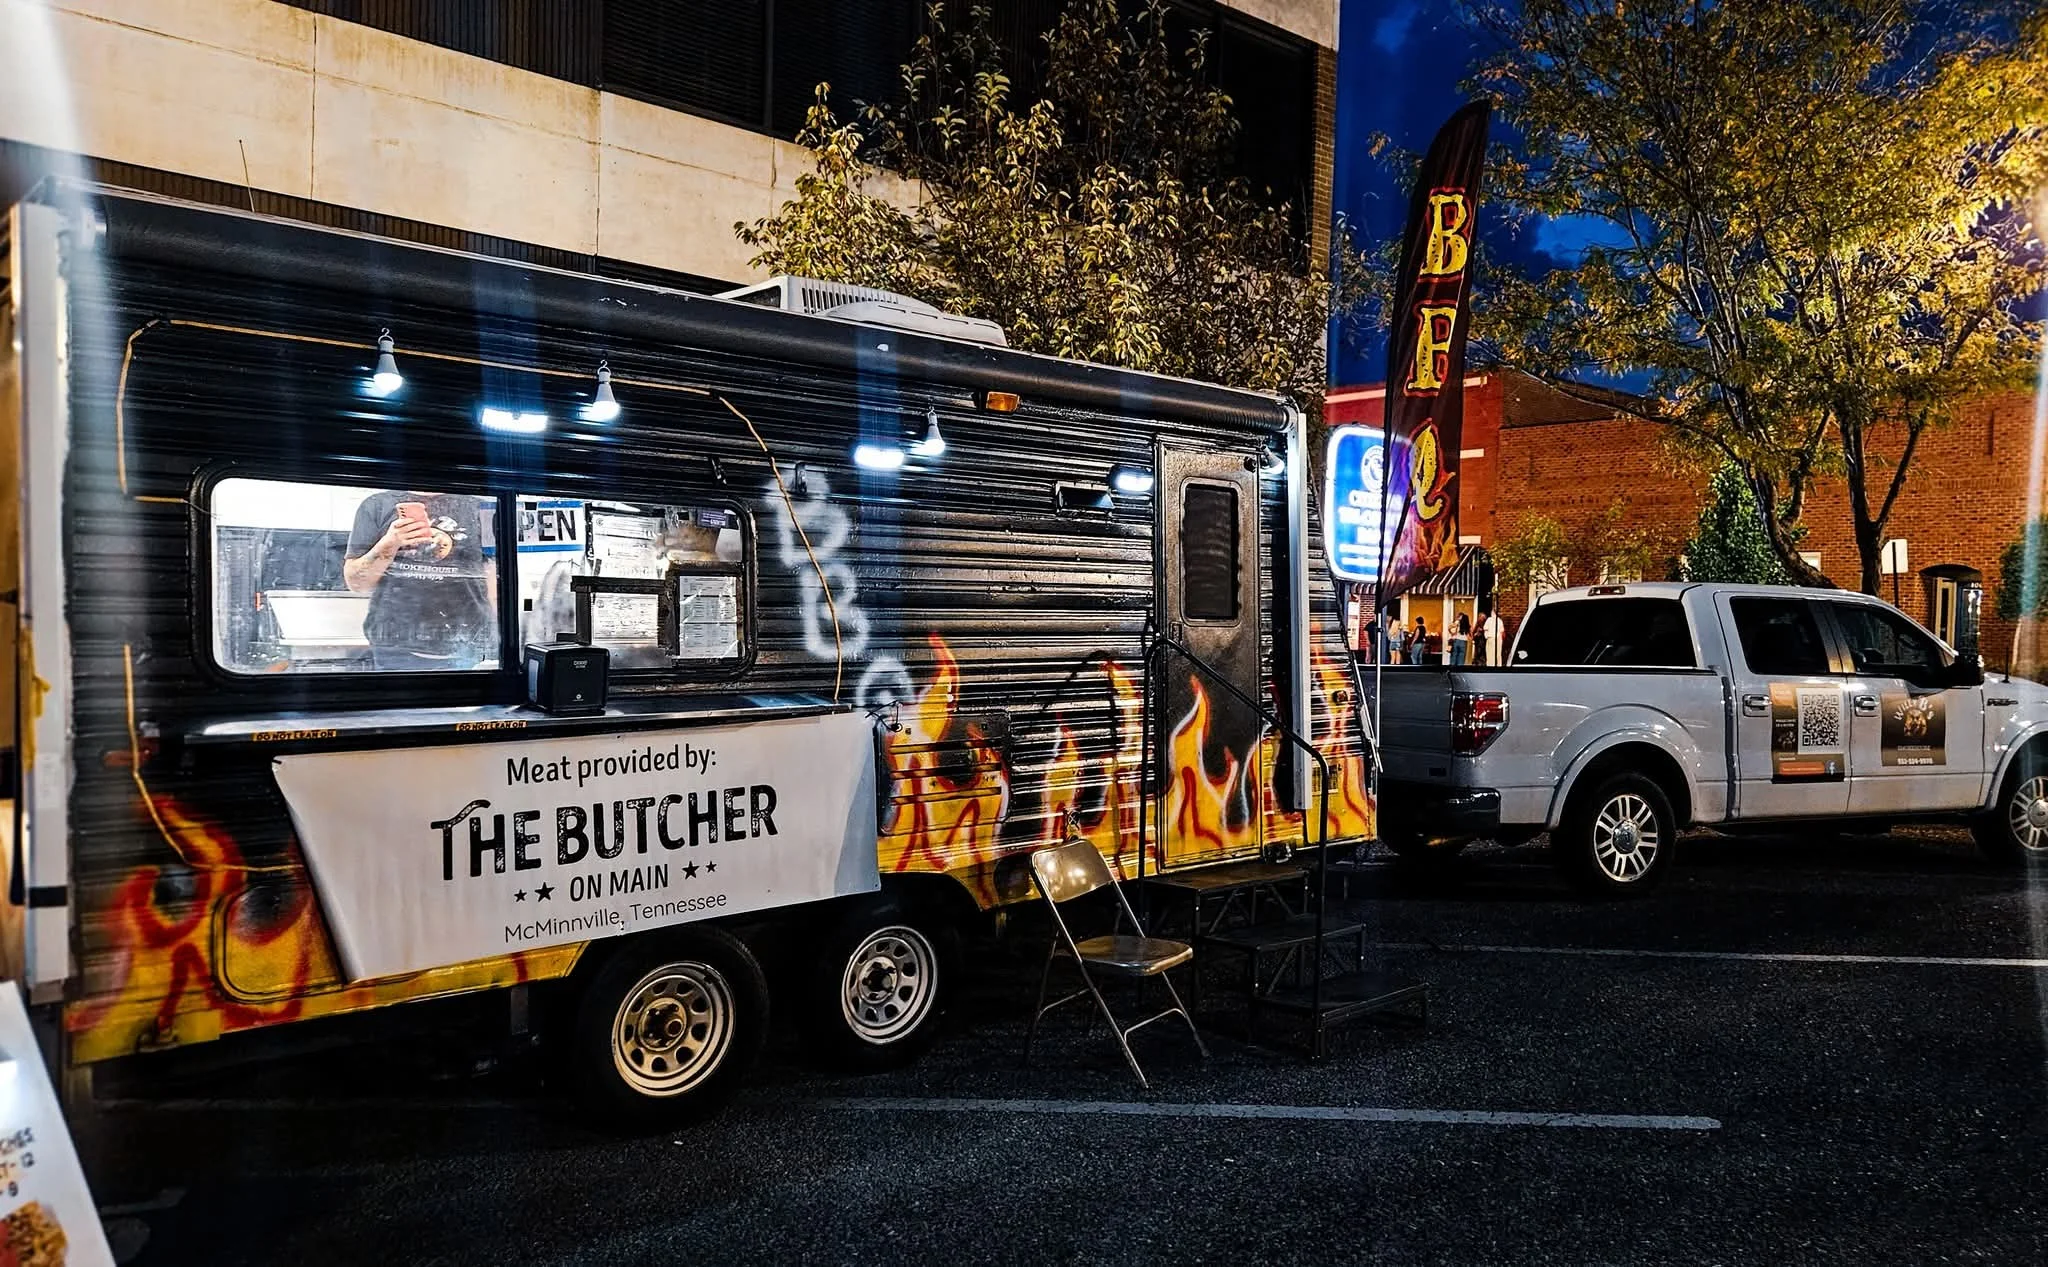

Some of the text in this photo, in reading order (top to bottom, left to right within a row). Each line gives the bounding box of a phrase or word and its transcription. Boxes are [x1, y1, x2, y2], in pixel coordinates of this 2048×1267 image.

[506, 743, 717, 788] Meat provided by:
[431, 784, 779, 881] THE BUTCHER
[569, 863, 669, 902] ON MAIN
[505, 892, 727, 943] McMinnville, Tennessee
